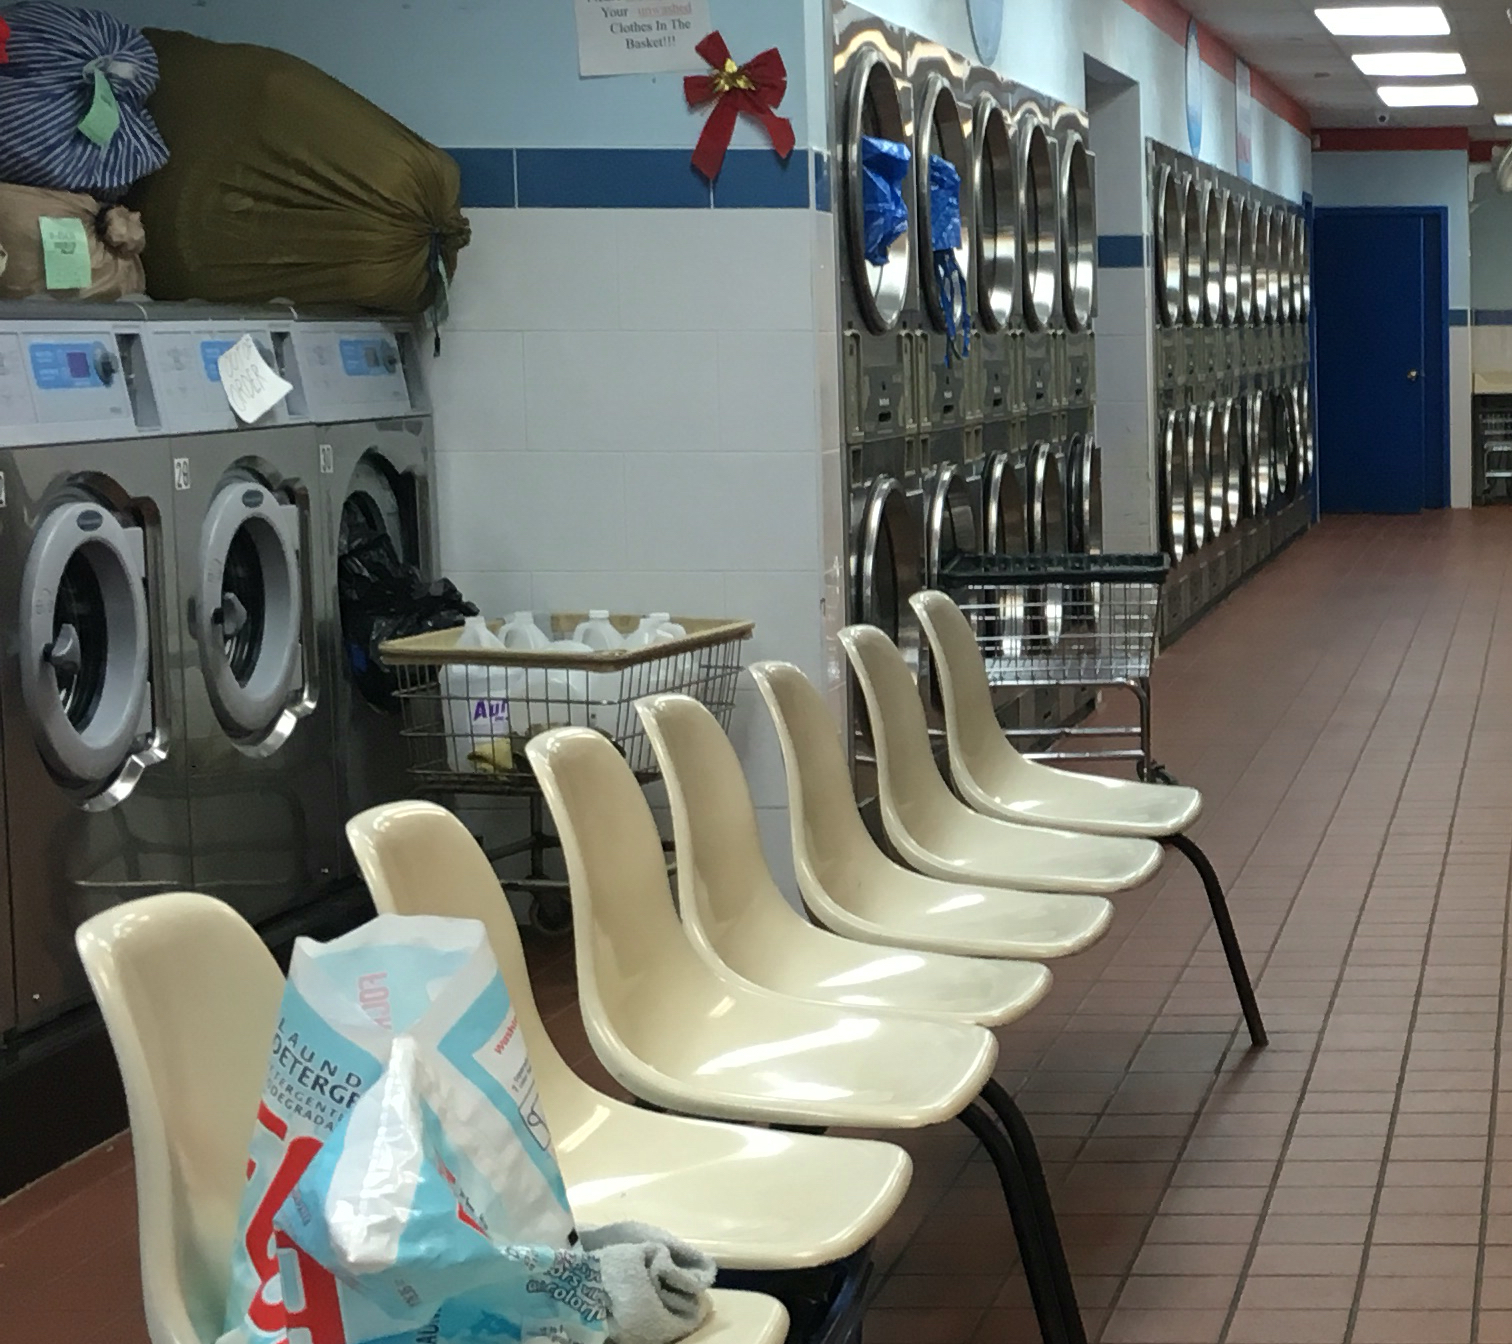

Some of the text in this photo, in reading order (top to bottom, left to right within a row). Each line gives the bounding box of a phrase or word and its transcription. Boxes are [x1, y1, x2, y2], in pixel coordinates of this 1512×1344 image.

[600, 7, 629, 18] Your
[609, 18, 691, 34] Clothes In The
[625, 35, 676, 50] Basket!!!
